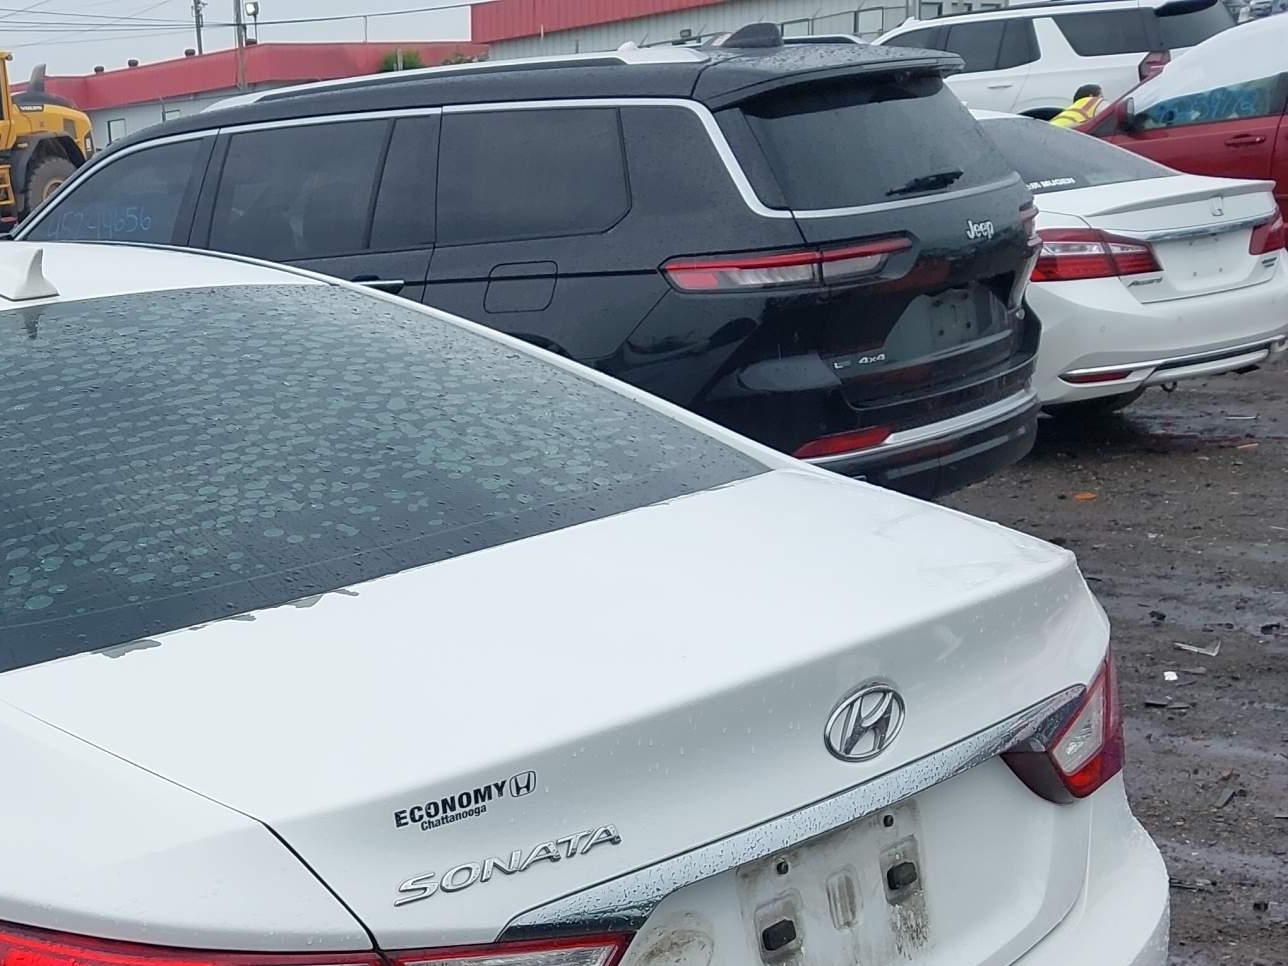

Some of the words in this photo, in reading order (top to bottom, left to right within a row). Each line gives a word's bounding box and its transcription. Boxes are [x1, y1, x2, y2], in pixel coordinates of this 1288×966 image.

[966, 220, 994, 239] Jeep
[858, 353, 886, 364] 4x4
[393, 779, 507, 828] ECONOMY
[420, 804, 487, 831] Chattanooga
[394, 824, 622, 907] SONATA
